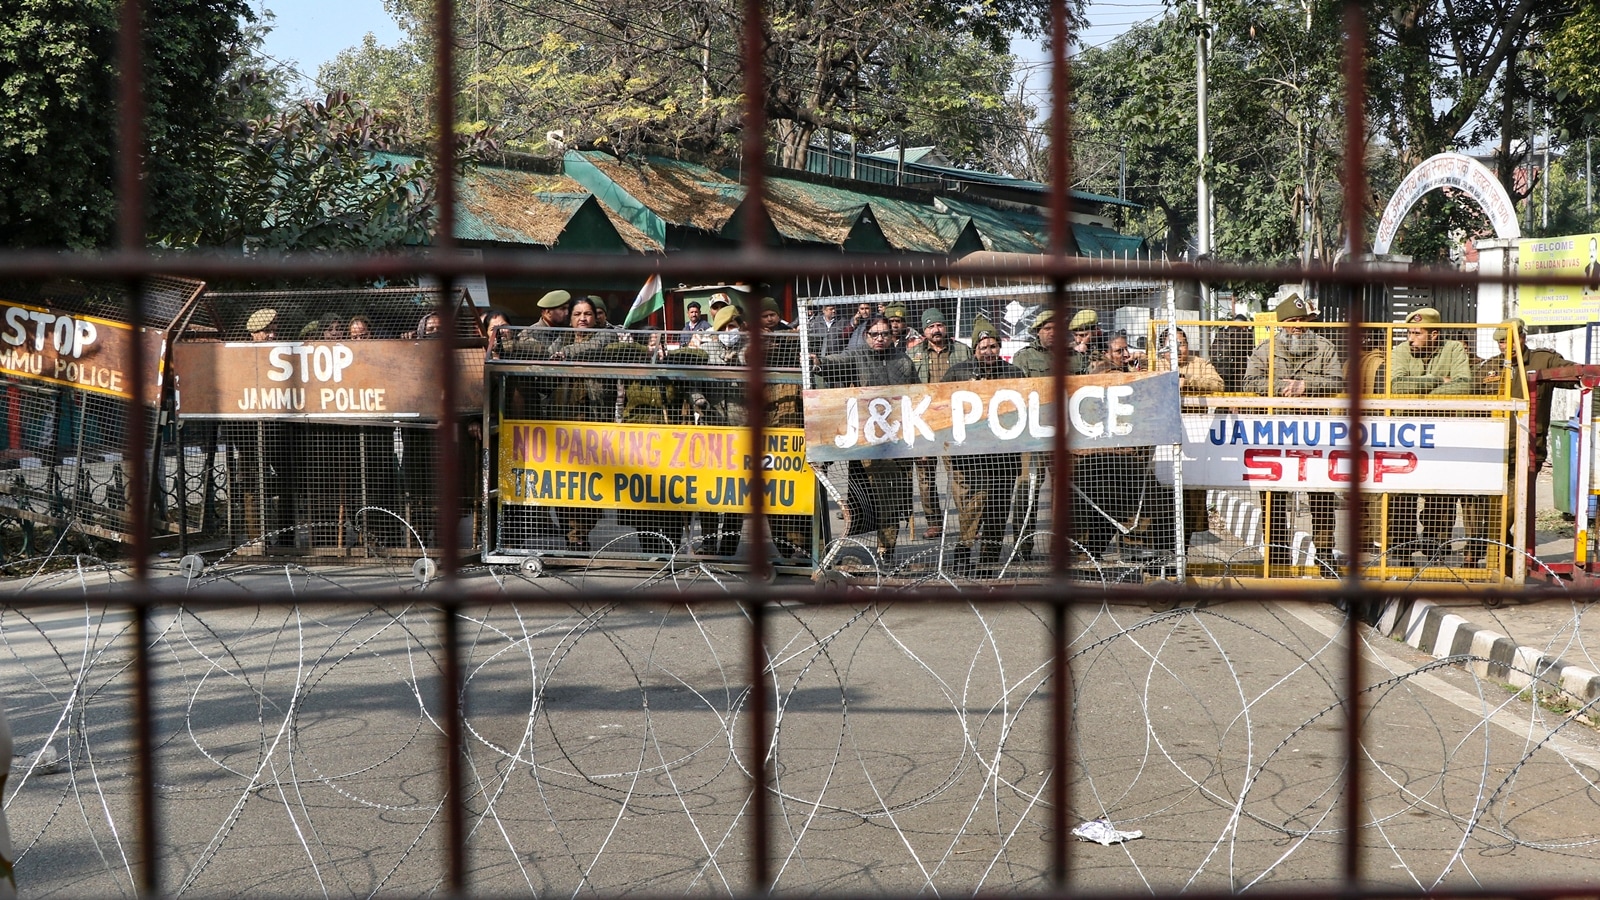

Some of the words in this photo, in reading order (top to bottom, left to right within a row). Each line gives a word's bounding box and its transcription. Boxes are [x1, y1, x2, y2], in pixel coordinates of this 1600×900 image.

[1531, 240, 1574, 252] WELCOME
[1535, 260, 1561, 270] BALIDAN
[1561, 258, 1580, 268] DIVAS
[1, 306, 97, 359] STOP
[54, 358, 123, 392] POLICE
[267, 343, 353, 383] STOP
[238, 388, 306, 411] JAMMU
[321, 388, 387, 411] POLICE
[834, 394, 935, 449] J&K
[1209, 420, 1321, 446] JAMMU
[1329, 421, 1436, 449] POLICE
[513, 425, 547, 463] NO
[555, 426, 661, 467] PARKING
[670, 431, 738, 470] ZONE
[792, 435, 807, 453] UP
[1242, 448, 1418, 483] STOP
[511, 467, 603, 501] TRAFFIC
[614, 472, 698, 506] POLICE
[706, 477, 795, 507] JAMMU
